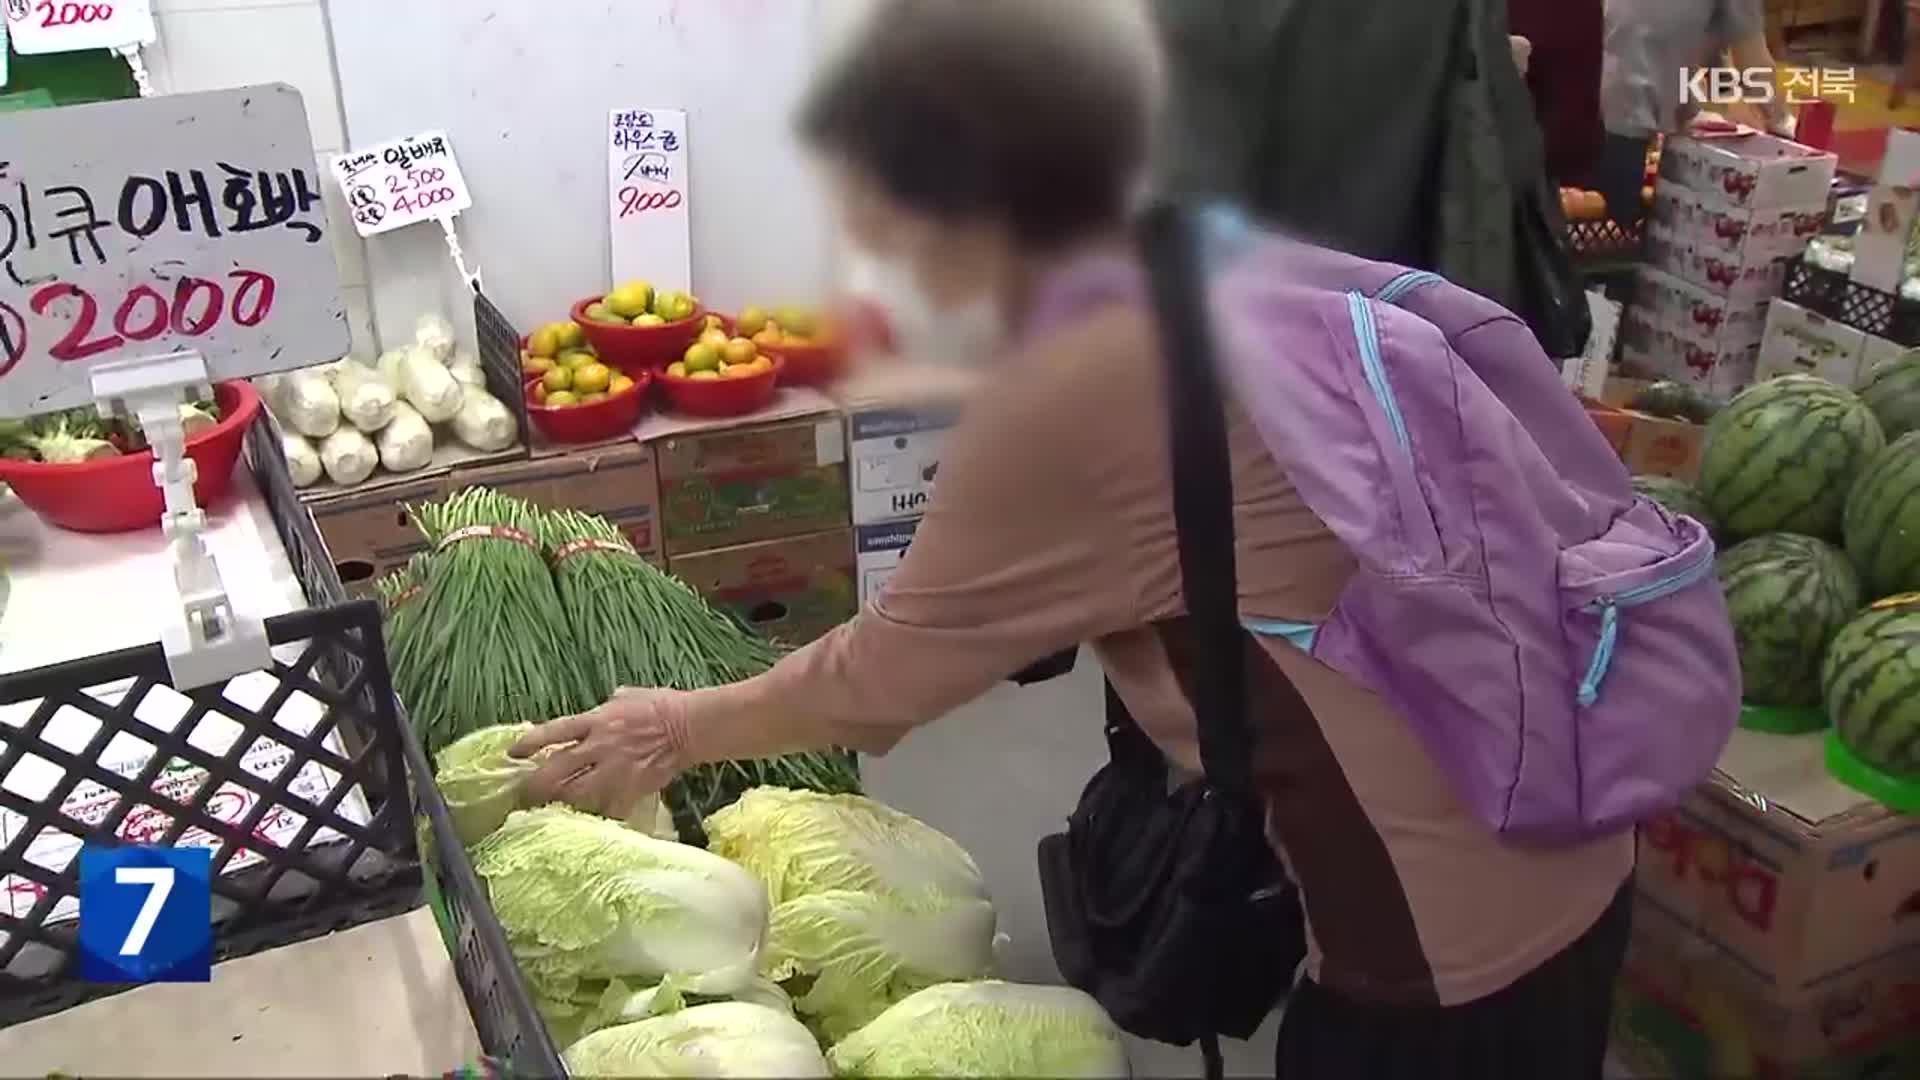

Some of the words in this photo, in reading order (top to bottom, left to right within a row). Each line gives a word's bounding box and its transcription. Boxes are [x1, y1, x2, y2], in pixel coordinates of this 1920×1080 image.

[36, 0, 113, 27] 2000
[385, 168, 445, 193] 2500
[30, 269, 275, 361] 2000
